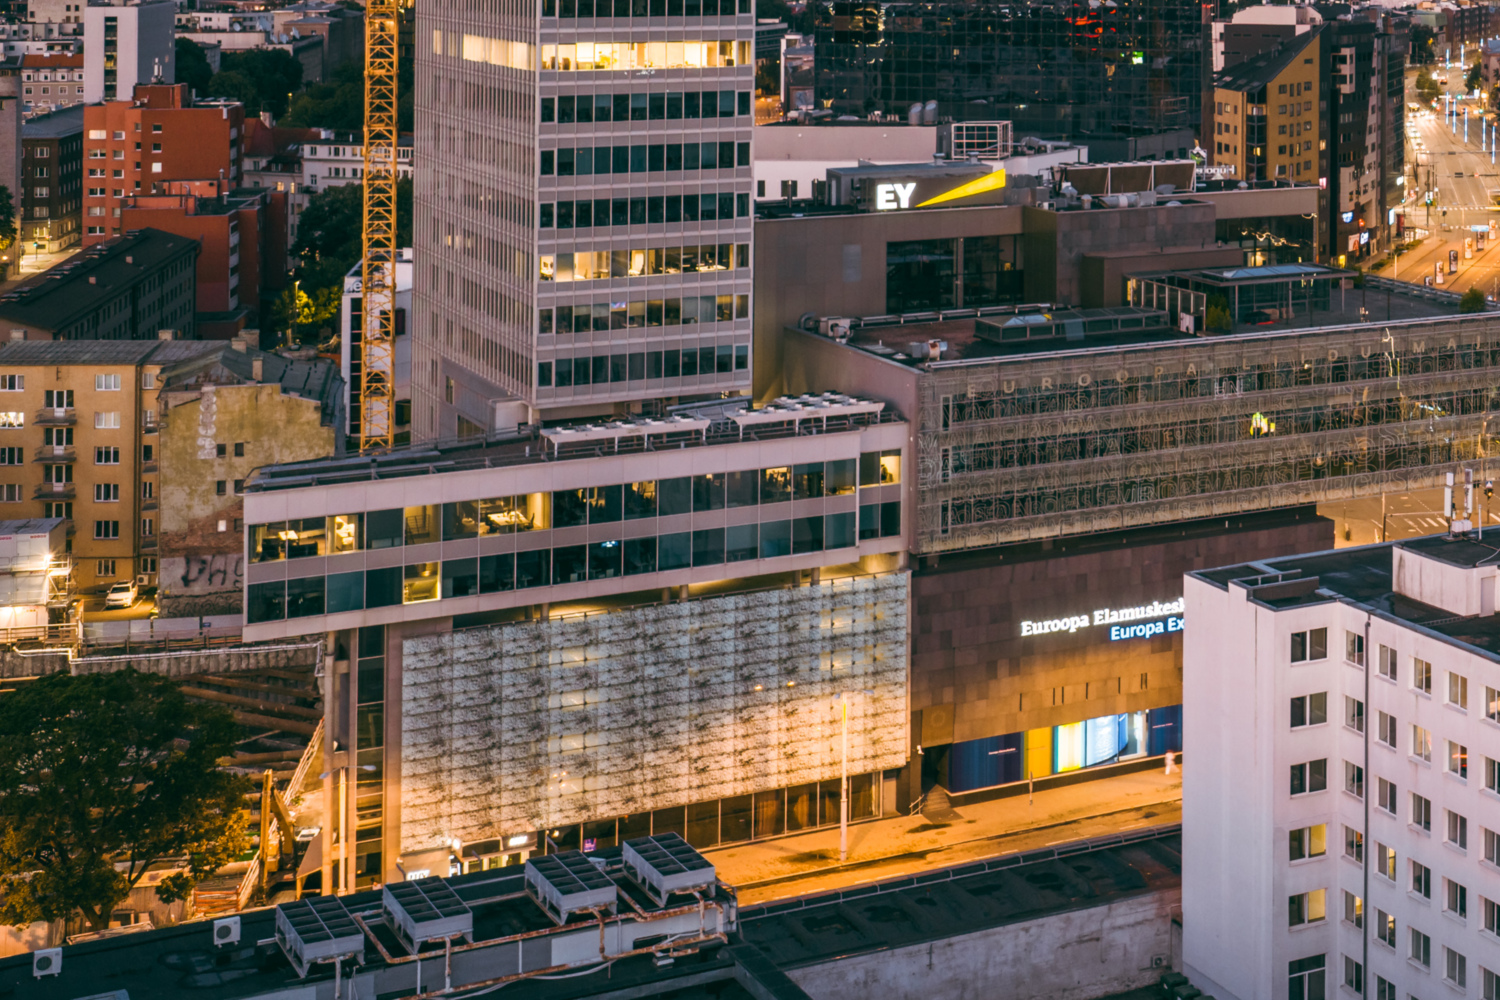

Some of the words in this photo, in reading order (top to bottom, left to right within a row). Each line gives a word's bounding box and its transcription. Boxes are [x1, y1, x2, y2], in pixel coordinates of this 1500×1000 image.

[876, 182, 916, 210] EY
[967, 362, 1198, 399] EUROOPA
[1021, 614, 1090, 636] Euroopa
[1111, 620, 1164, 640] Europa
